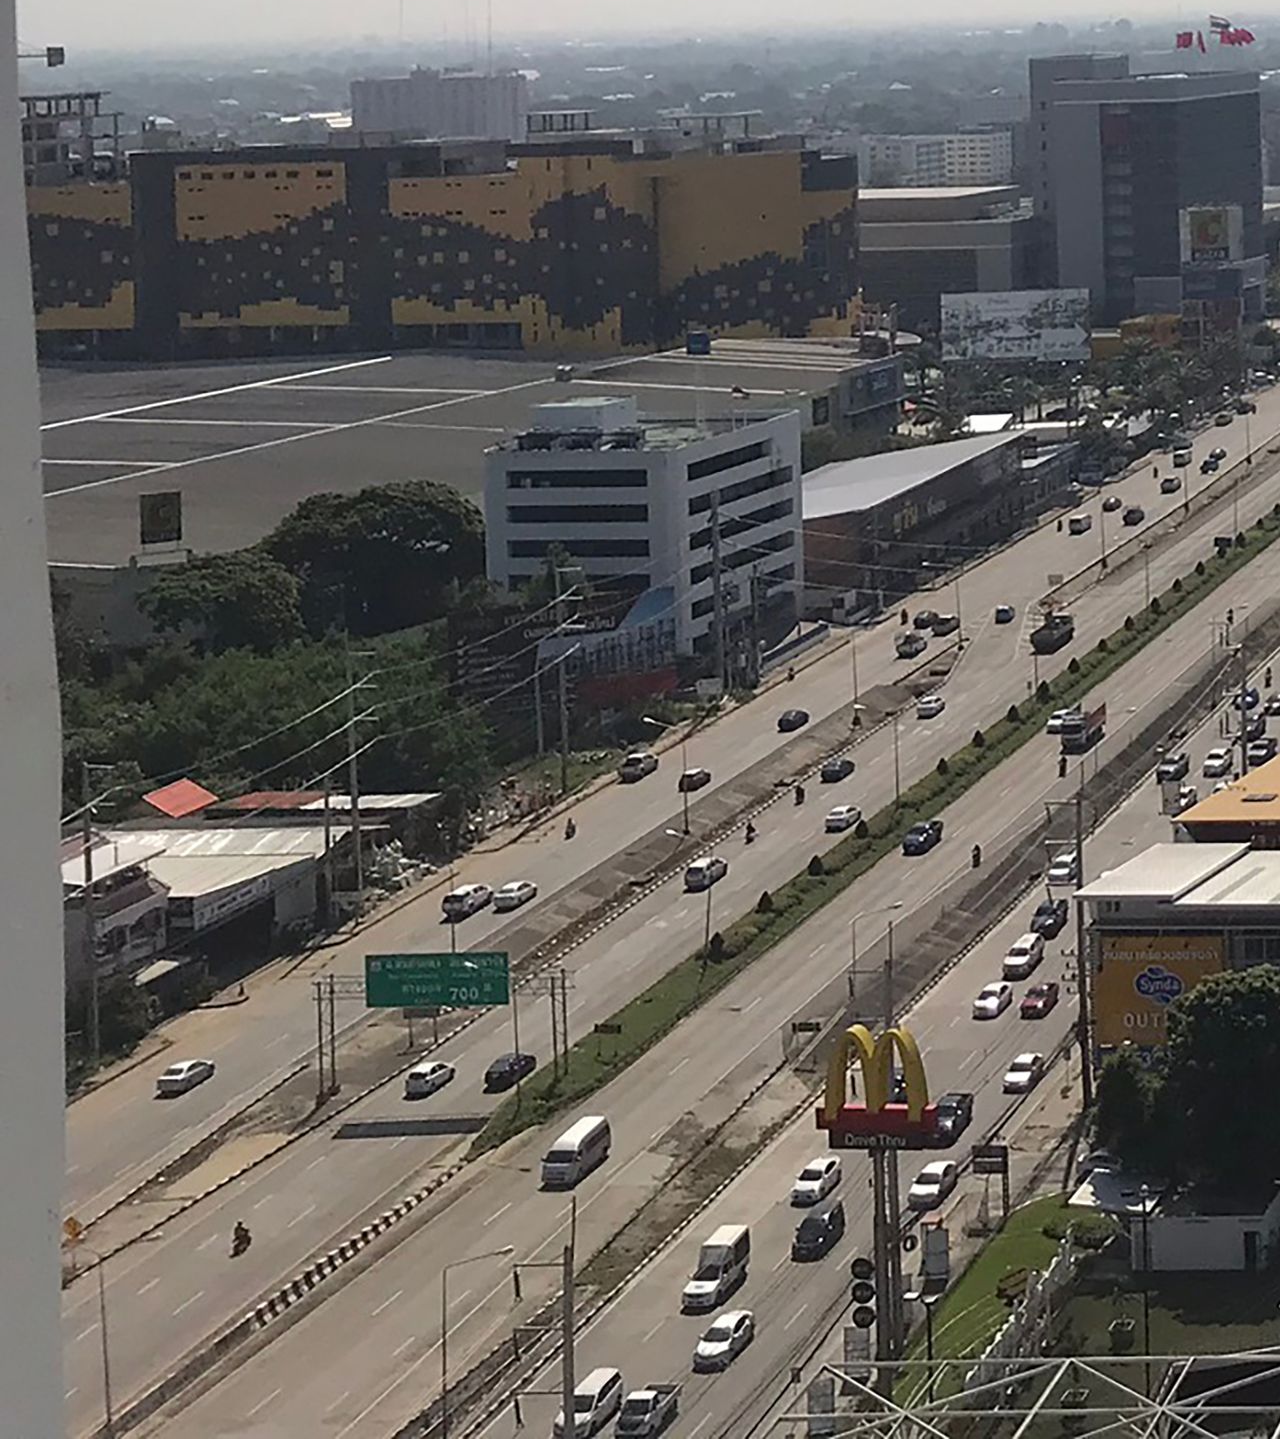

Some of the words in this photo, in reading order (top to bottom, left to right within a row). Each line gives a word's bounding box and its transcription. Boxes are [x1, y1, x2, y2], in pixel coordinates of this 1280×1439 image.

[449, 987, 479, 1001] 700
[844, 1132, 877, 1146] Drive
[877, 1133, 907, 1147] Thru
